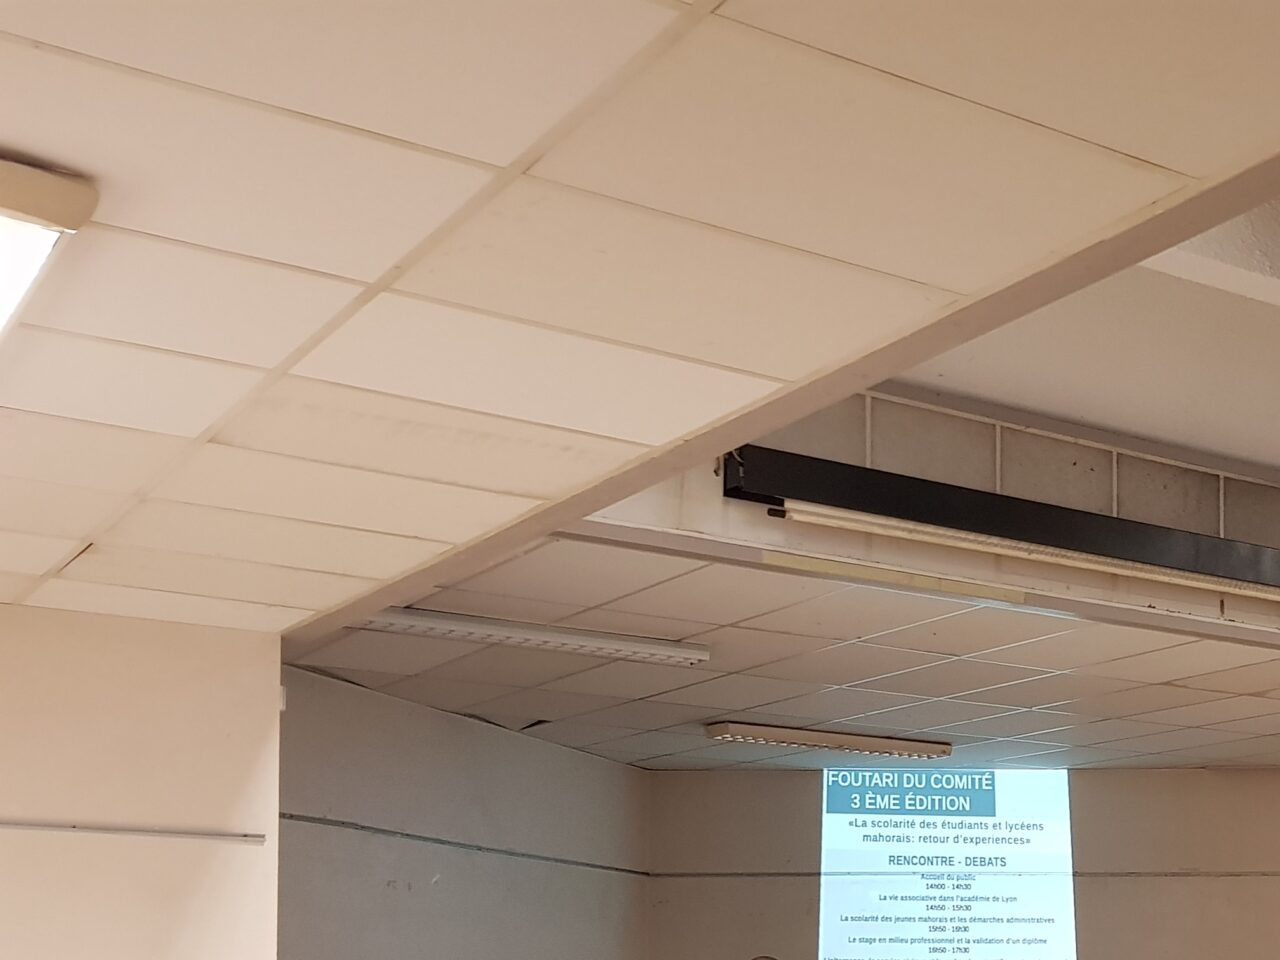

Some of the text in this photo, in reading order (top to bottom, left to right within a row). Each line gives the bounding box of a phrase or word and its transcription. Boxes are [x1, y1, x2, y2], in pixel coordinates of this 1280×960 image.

[828, 771, 992, 789] FOUTARI DU COMITÉ
[851, 791, 970, 811] 3 ÈME ÉDITION
[871, 819, 916, 829] scolarité
[919, 820, 937, 829] des
[941, 821, 988, 830] étudiants
[993, 822, 1002, 830] et
[1005, 821, 1044, 832] lycéens
[863, 833, 915, 843] mahorais:
[918, 834, 950, 843] retour
[888, 856, 955, 866] RENCONTRE
[965, 856, 1006, 867] DEBATS
[1001, 896, 1017, 904] Lyon
[894, 915, 915, 924] jeunes
[859, 937, 876, 945] stage
